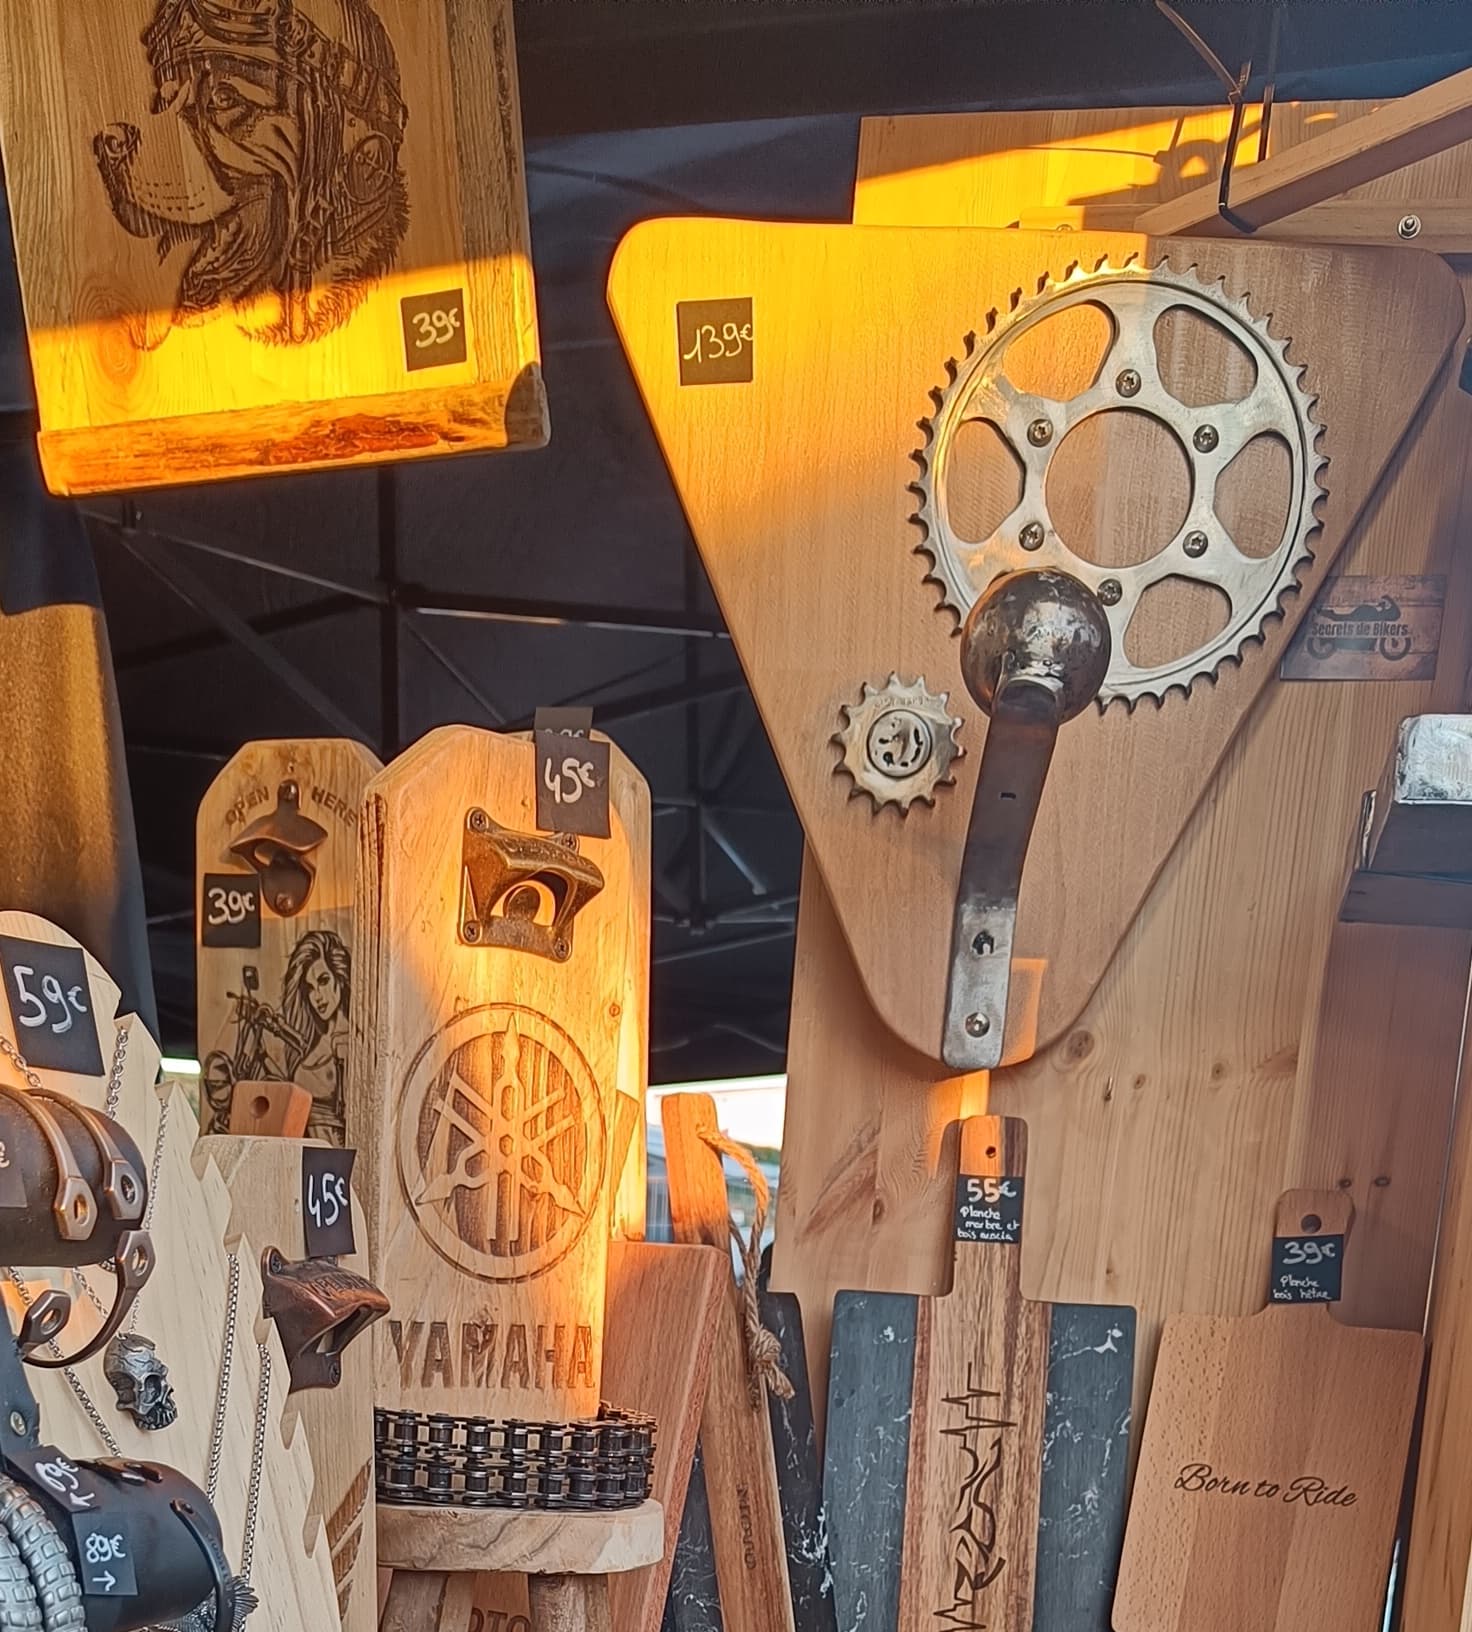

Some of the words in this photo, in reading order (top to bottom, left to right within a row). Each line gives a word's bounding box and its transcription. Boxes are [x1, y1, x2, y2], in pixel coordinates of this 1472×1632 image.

[412, 307, 461, 348] 39€
[683, 322, 753, 364] 139€
[1311, 621, 1354, 636] Secrets
[1355, 621, 1371, 636] de
[1373, 621, 1409, 636] Bikers
[544, 757, 596, 804] 45€
[225, 786, 270, 826] OPEN
[311, 786, 358, 828] HERE
[207, 887, 256, 925] 39€
[12, 965, 88, 1034] 59€
[307, 1172, 349, 1228] 45€
[967, 1178, 1017, 1203] 55€
[1282, 1241, 1336, 1265] 39€
[388, 1319, 596, 1391] YAMAHA
[1174, 1462, 1251, 1496] Born
[1253, 1479, 1281, 1499] to
[1282, 1476, 1359, 1508] Ride
[84, 1532, 127, 1564] 89€
